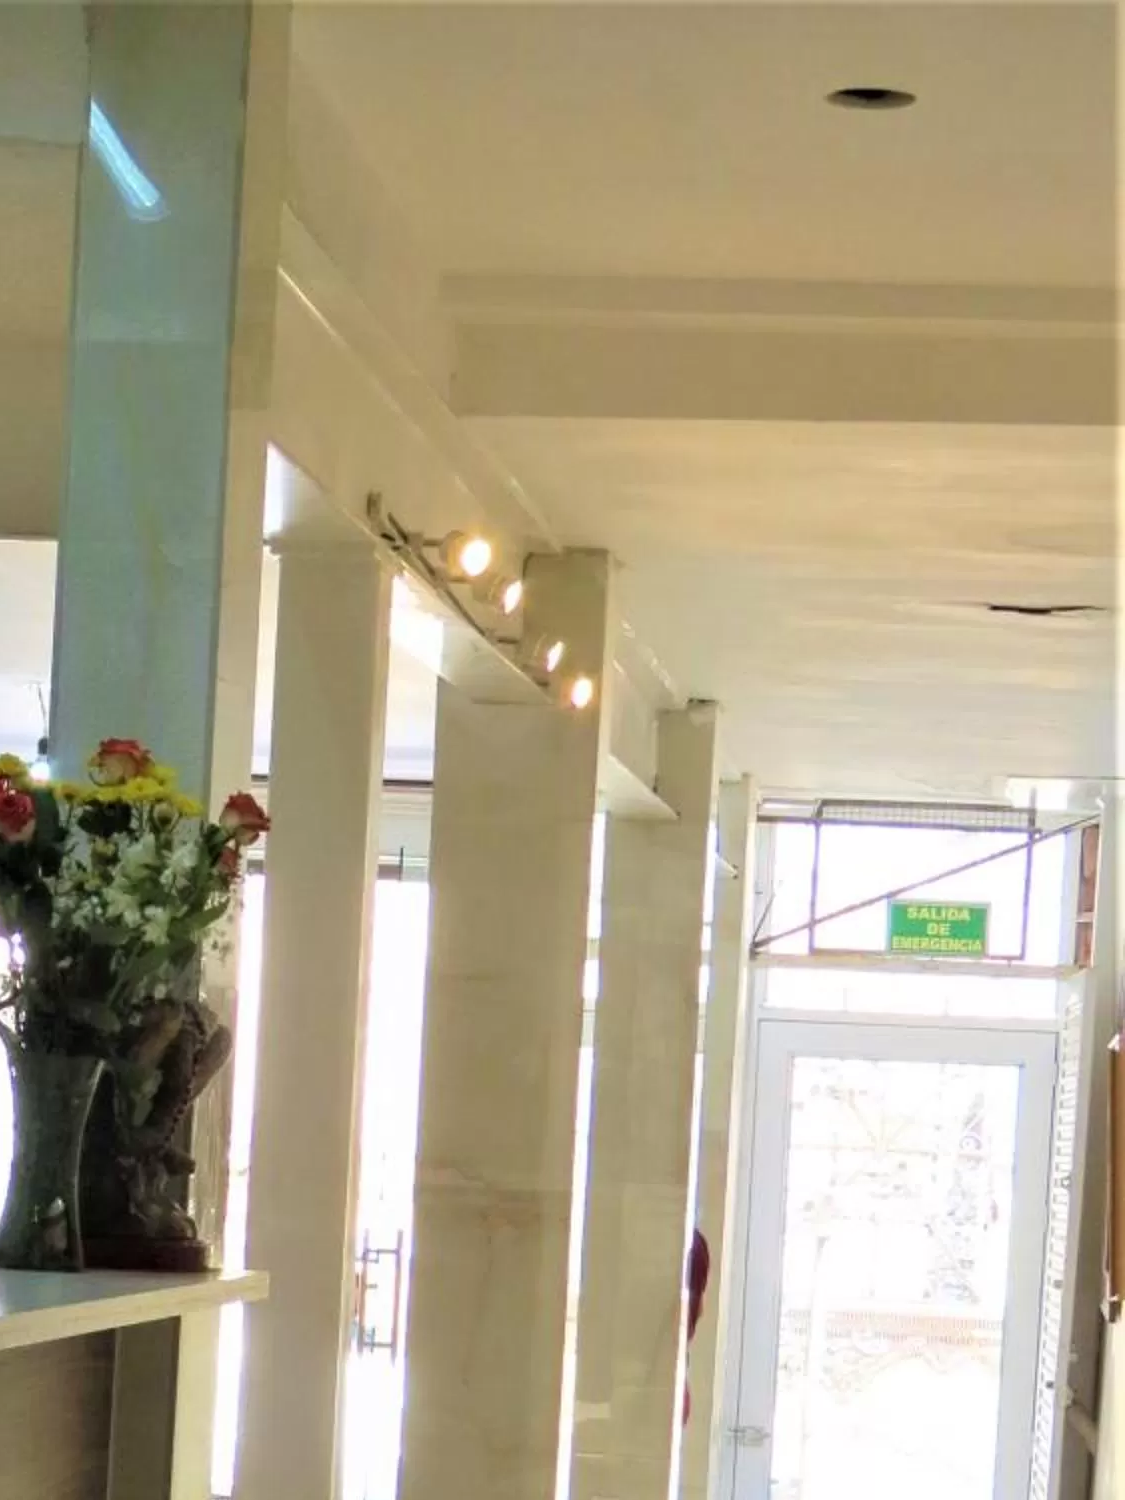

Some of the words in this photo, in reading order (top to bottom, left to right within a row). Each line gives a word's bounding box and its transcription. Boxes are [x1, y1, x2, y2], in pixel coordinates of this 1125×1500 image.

[906, 907, 971, 921] SALIDA
[926, 922, 951, 935] DE
[892, 936, 982, 952] EMERGENCIA
